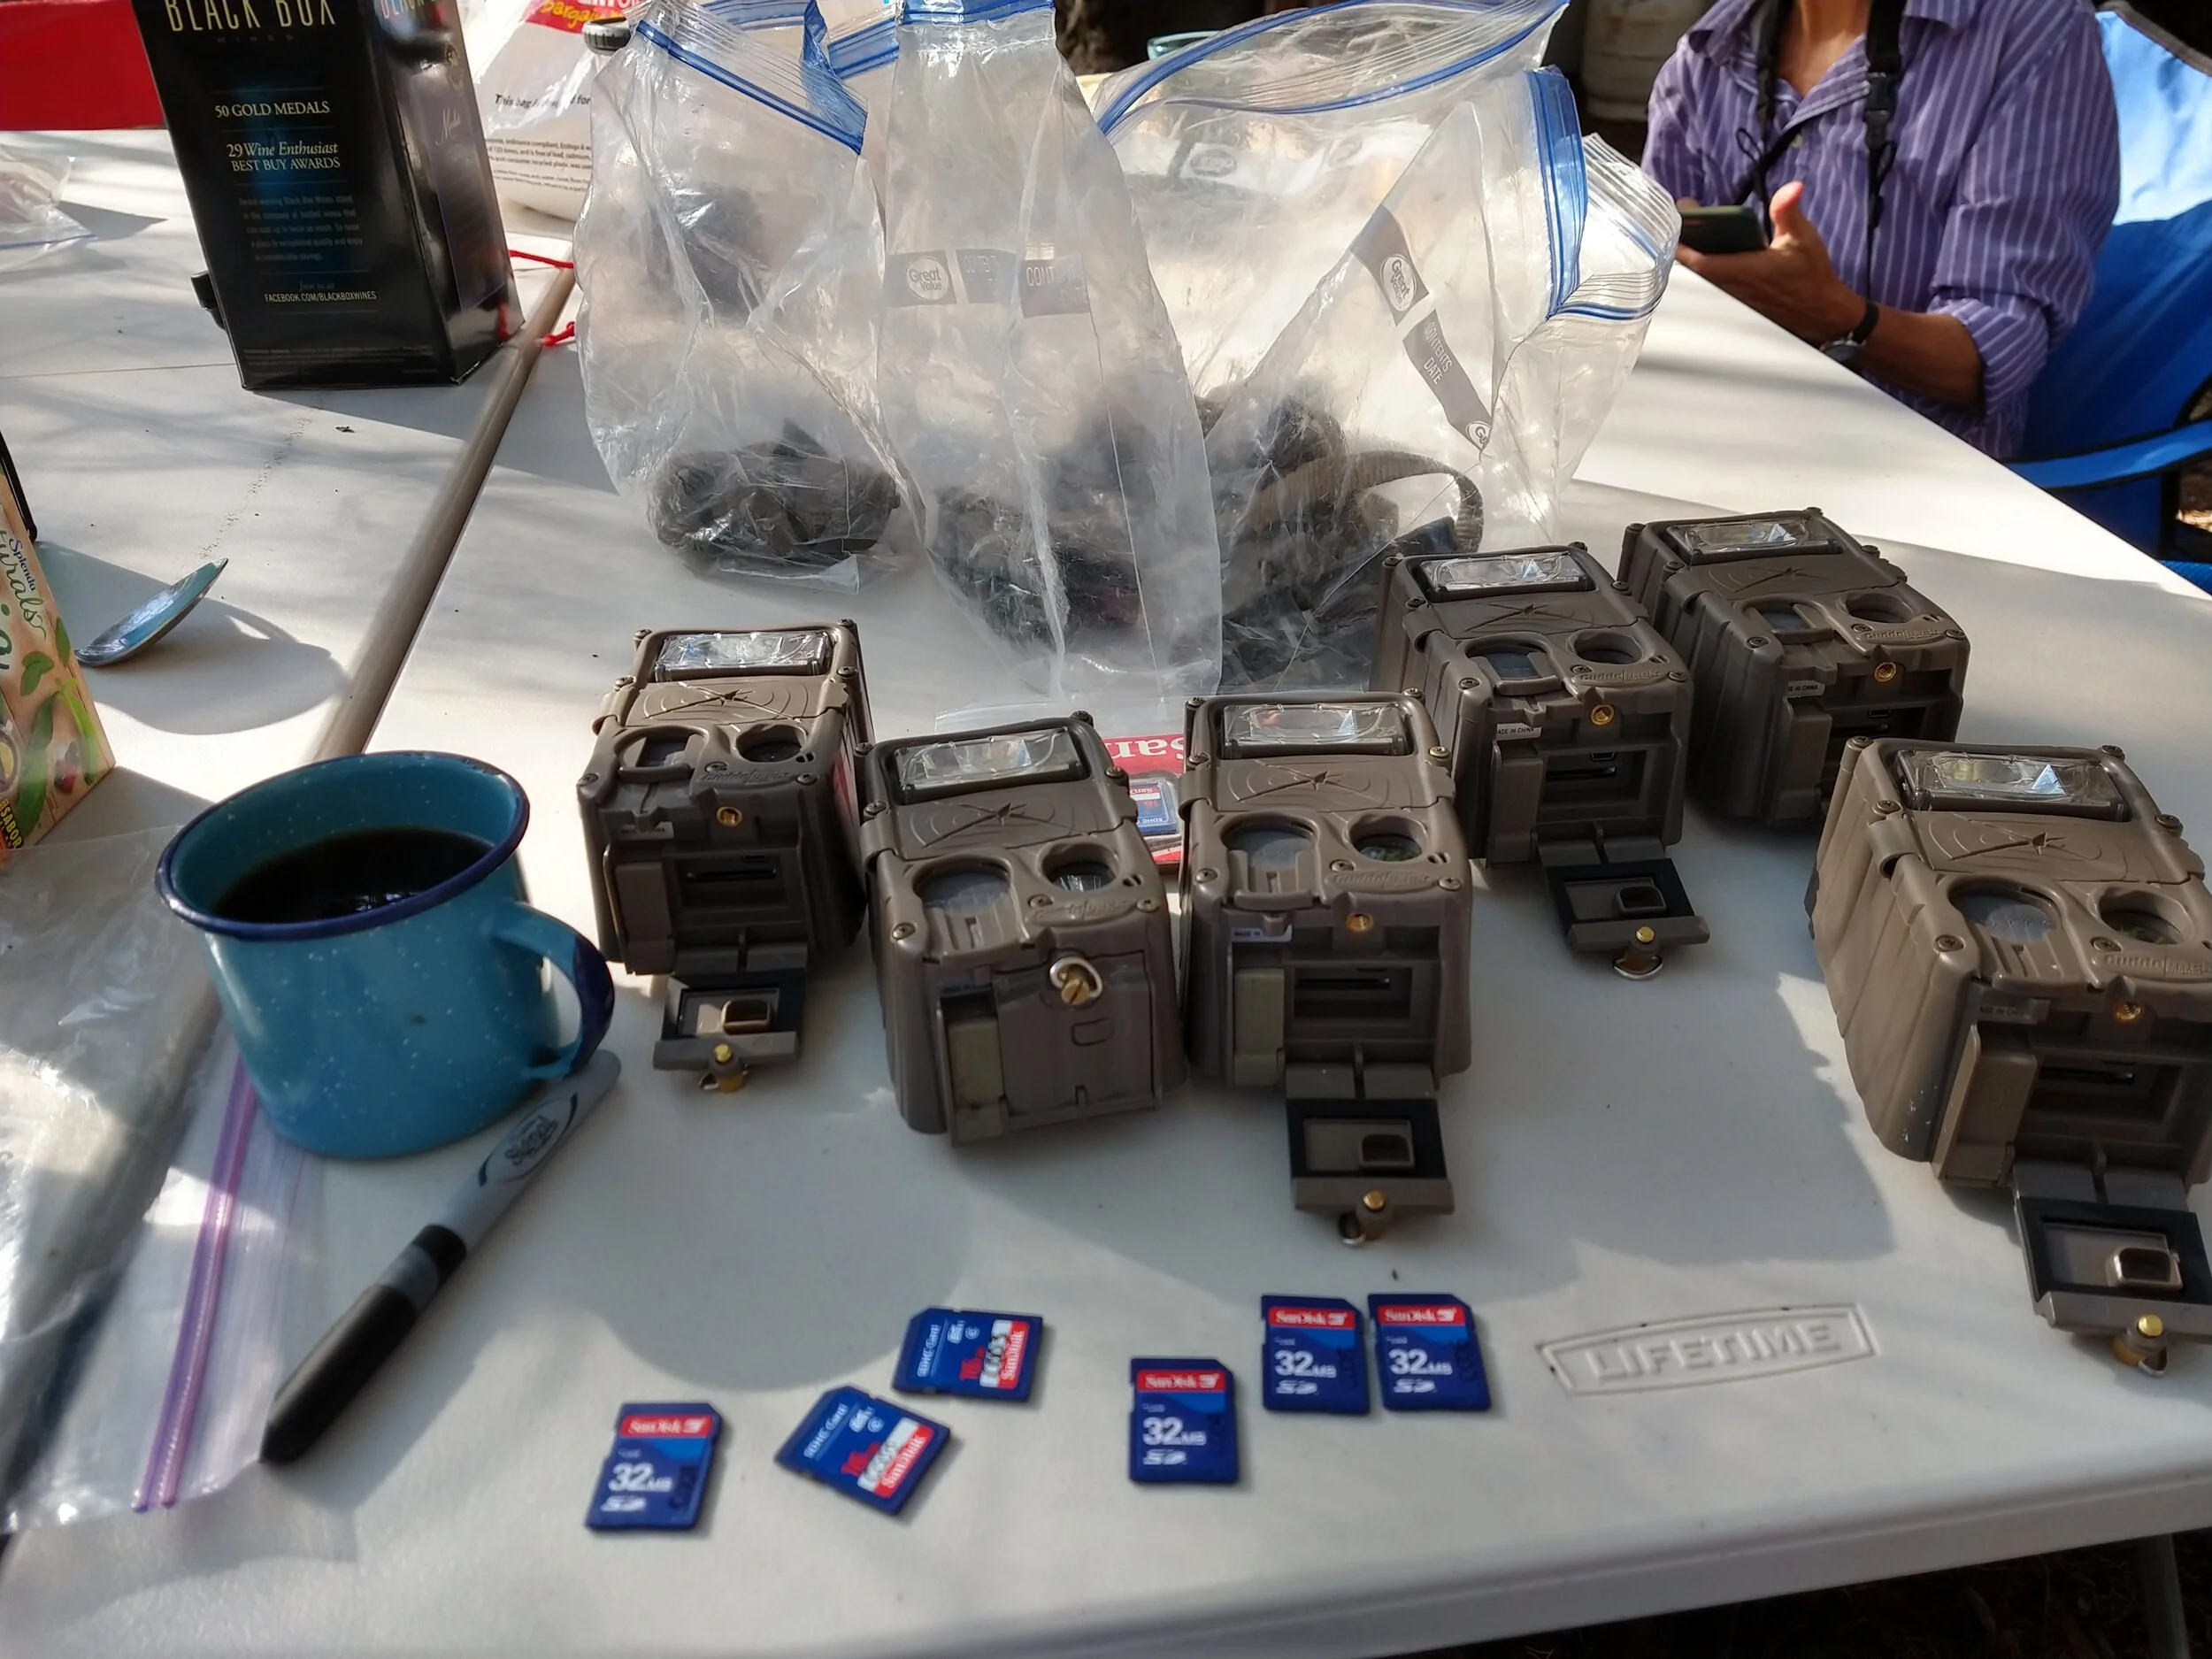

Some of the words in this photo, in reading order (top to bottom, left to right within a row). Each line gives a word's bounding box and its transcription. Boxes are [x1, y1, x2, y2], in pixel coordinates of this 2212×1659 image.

[215, 105, 230, 118] 50
[231, 103, 272, 117] GOLD
[274, 100, 330, 115] MEDALS
[227, 143, 243, 157] 29
[244, 142, 275, 157] Wine
[279, 140, 338, 156] Enthusiast
[232, 159, 261, 172] BEST
[263, 158, 288, 171] BUY
[290, 157, 341, 170] AWARDS
[909, 266, 942, 283] Great
[1390, 258, 1410, 300] Great
[919, 279, 943, 292] Value
[1388, 274, 1404, 305] Value
[265, 290, 377, 303] FACEBOOK.COM/BLACKBOXWINES
[1424, 321, 1453, 373] CONTENTS
[1424, 357, 1444, 385] DATE
[9, 538, 36, 591] Splenda
[1275, 1310, 1326, 1325] SanDisk
[1384, 1309, 1436, 1323] SanDisk
[1000, 1330, 1025, 1380] SanDisk
[1585, 1321, 1842, 1383] LIFETIME
[1145, 1373, 1198, 1389] SanDisk
[628, 1417, 681, 1434] SanDisk
[881, 1434, 927, 1489] SanDisk
